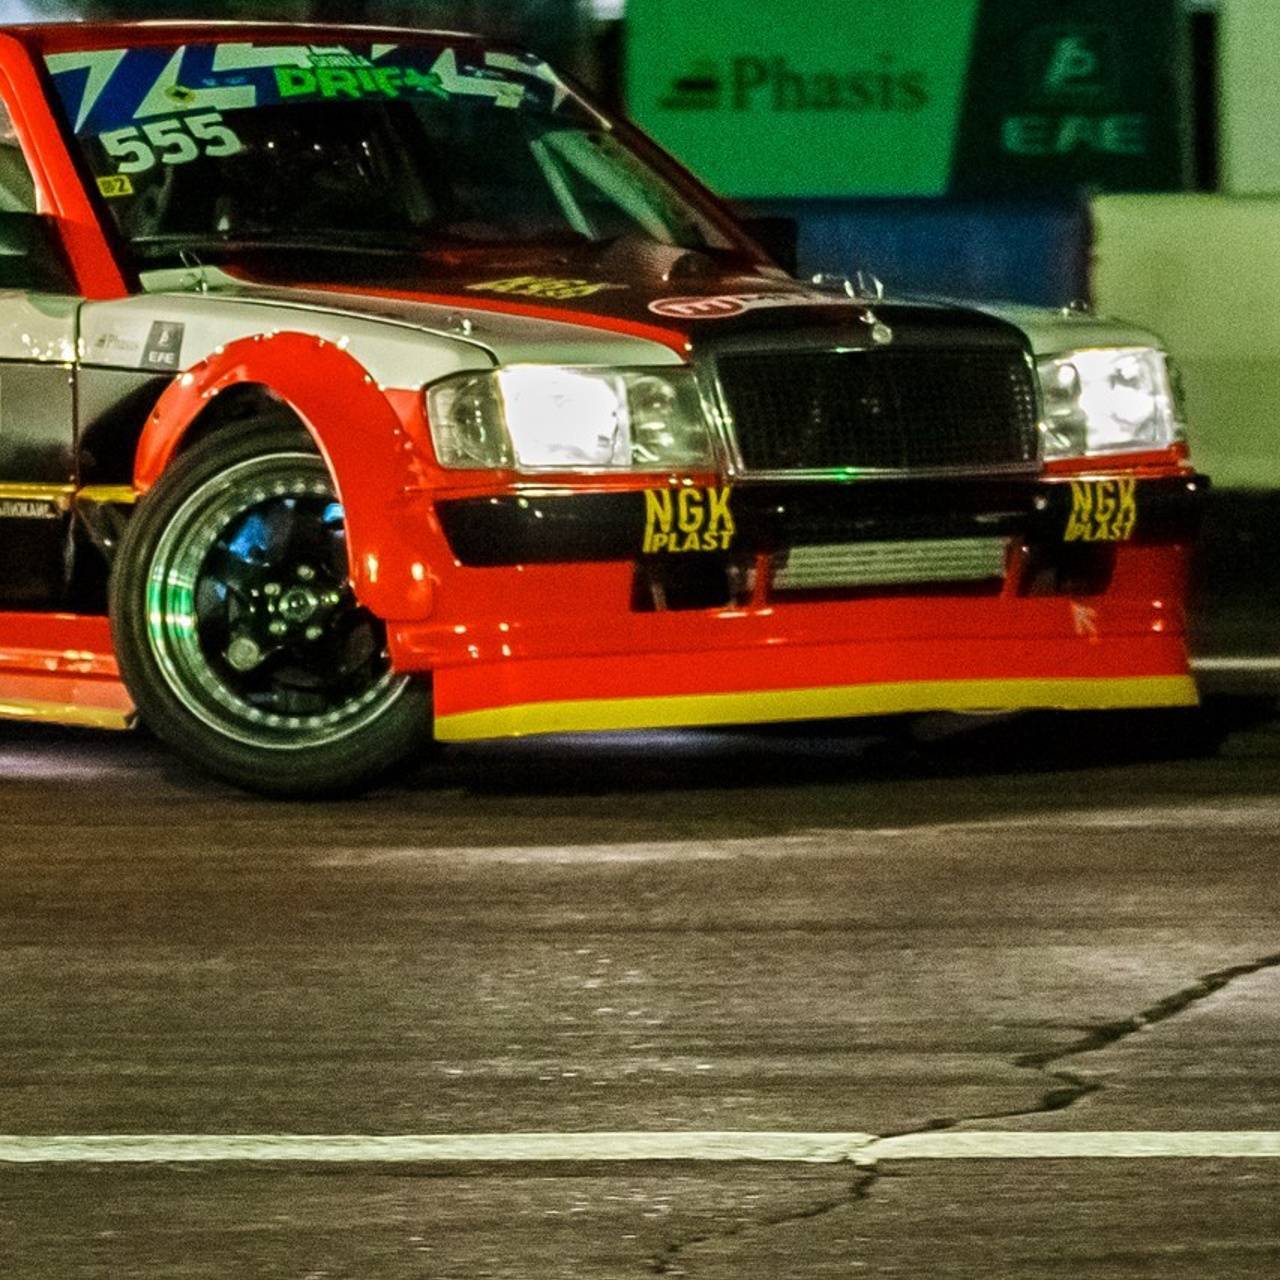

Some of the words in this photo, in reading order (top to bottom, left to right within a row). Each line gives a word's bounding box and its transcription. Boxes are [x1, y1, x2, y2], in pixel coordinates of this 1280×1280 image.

[731, 52, 931, 112] Phasis
[99, 113, 243, 173] 555
[643, 486, 735, 533] NGK
[1070, 479, 1136, 523] NGK
[648, 530, 734, 553] PLAST
